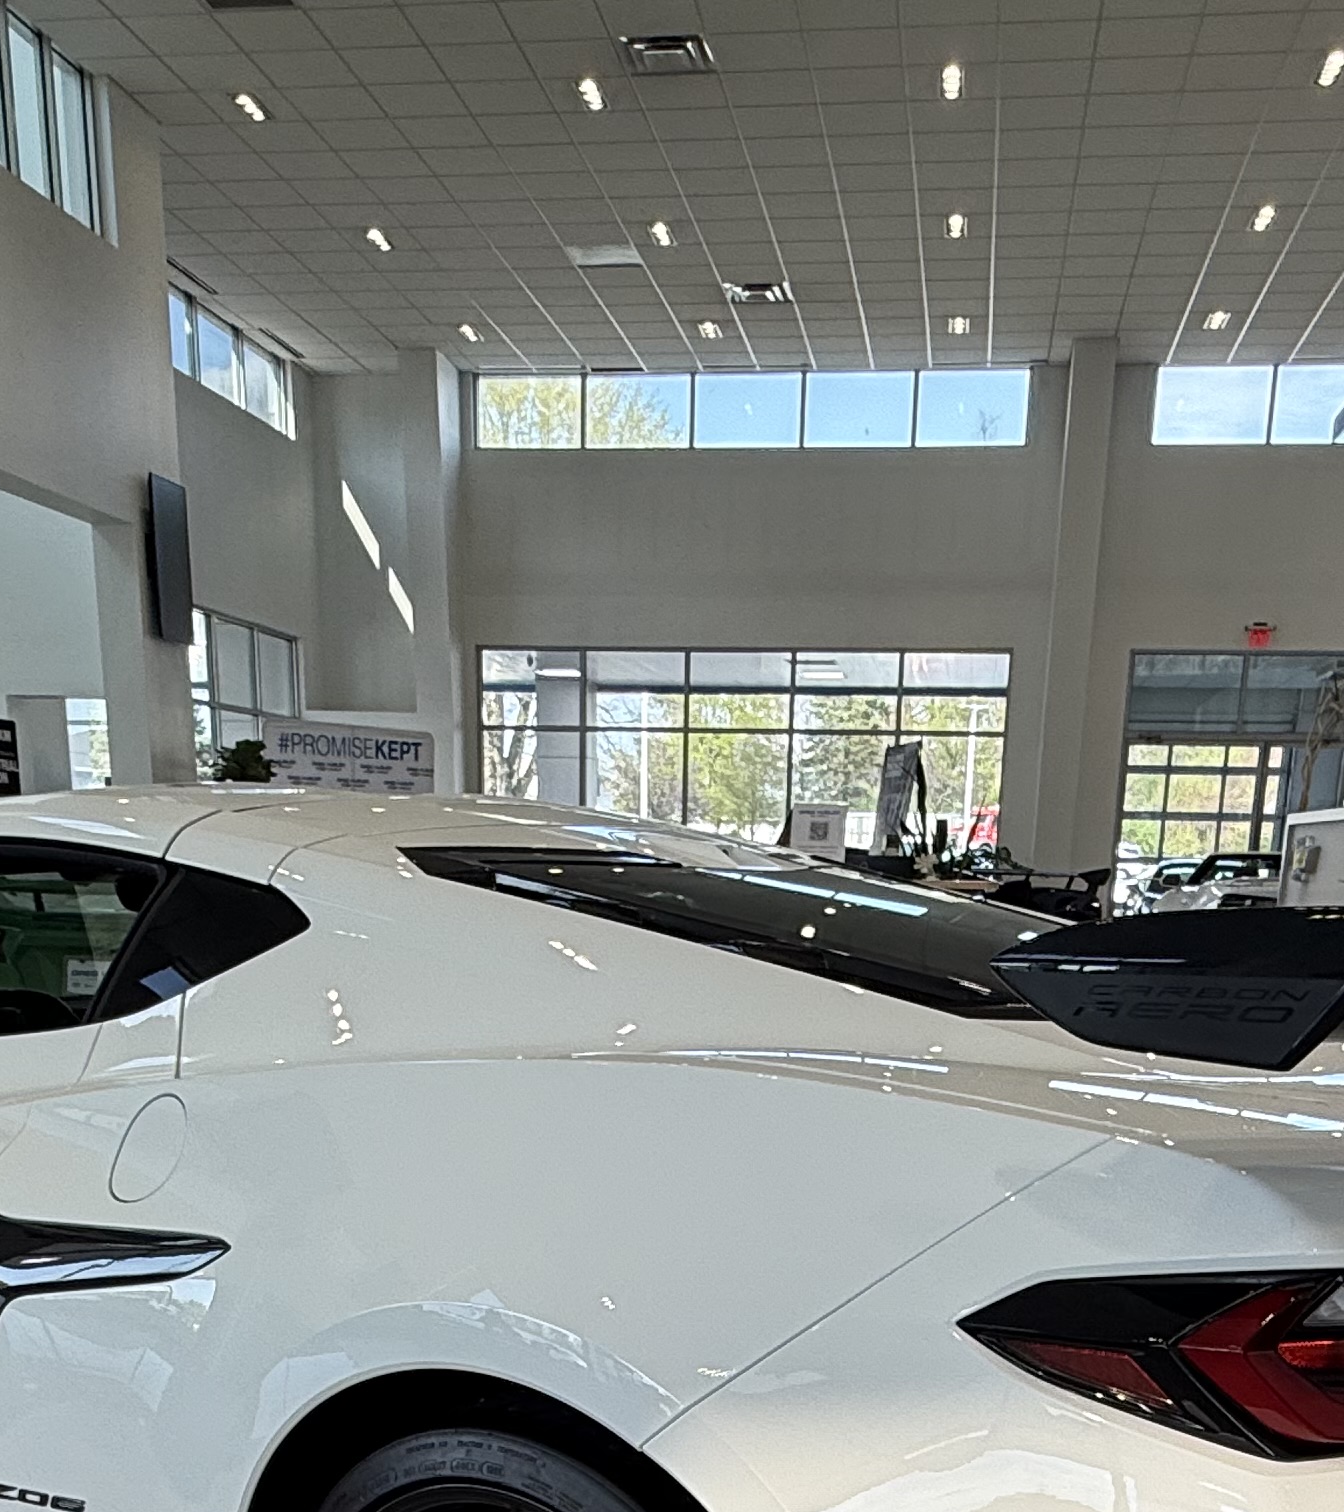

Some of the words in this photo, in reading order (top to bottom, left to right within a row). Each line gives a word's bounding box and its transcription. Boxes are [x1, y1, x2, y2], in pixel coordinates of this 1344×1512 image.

[278, 733, 423, 761] #PROMISEKEPT
[1088, 984, 1311, 1001] CARBON
[1073, 1001, 1295, 1023] AERO
